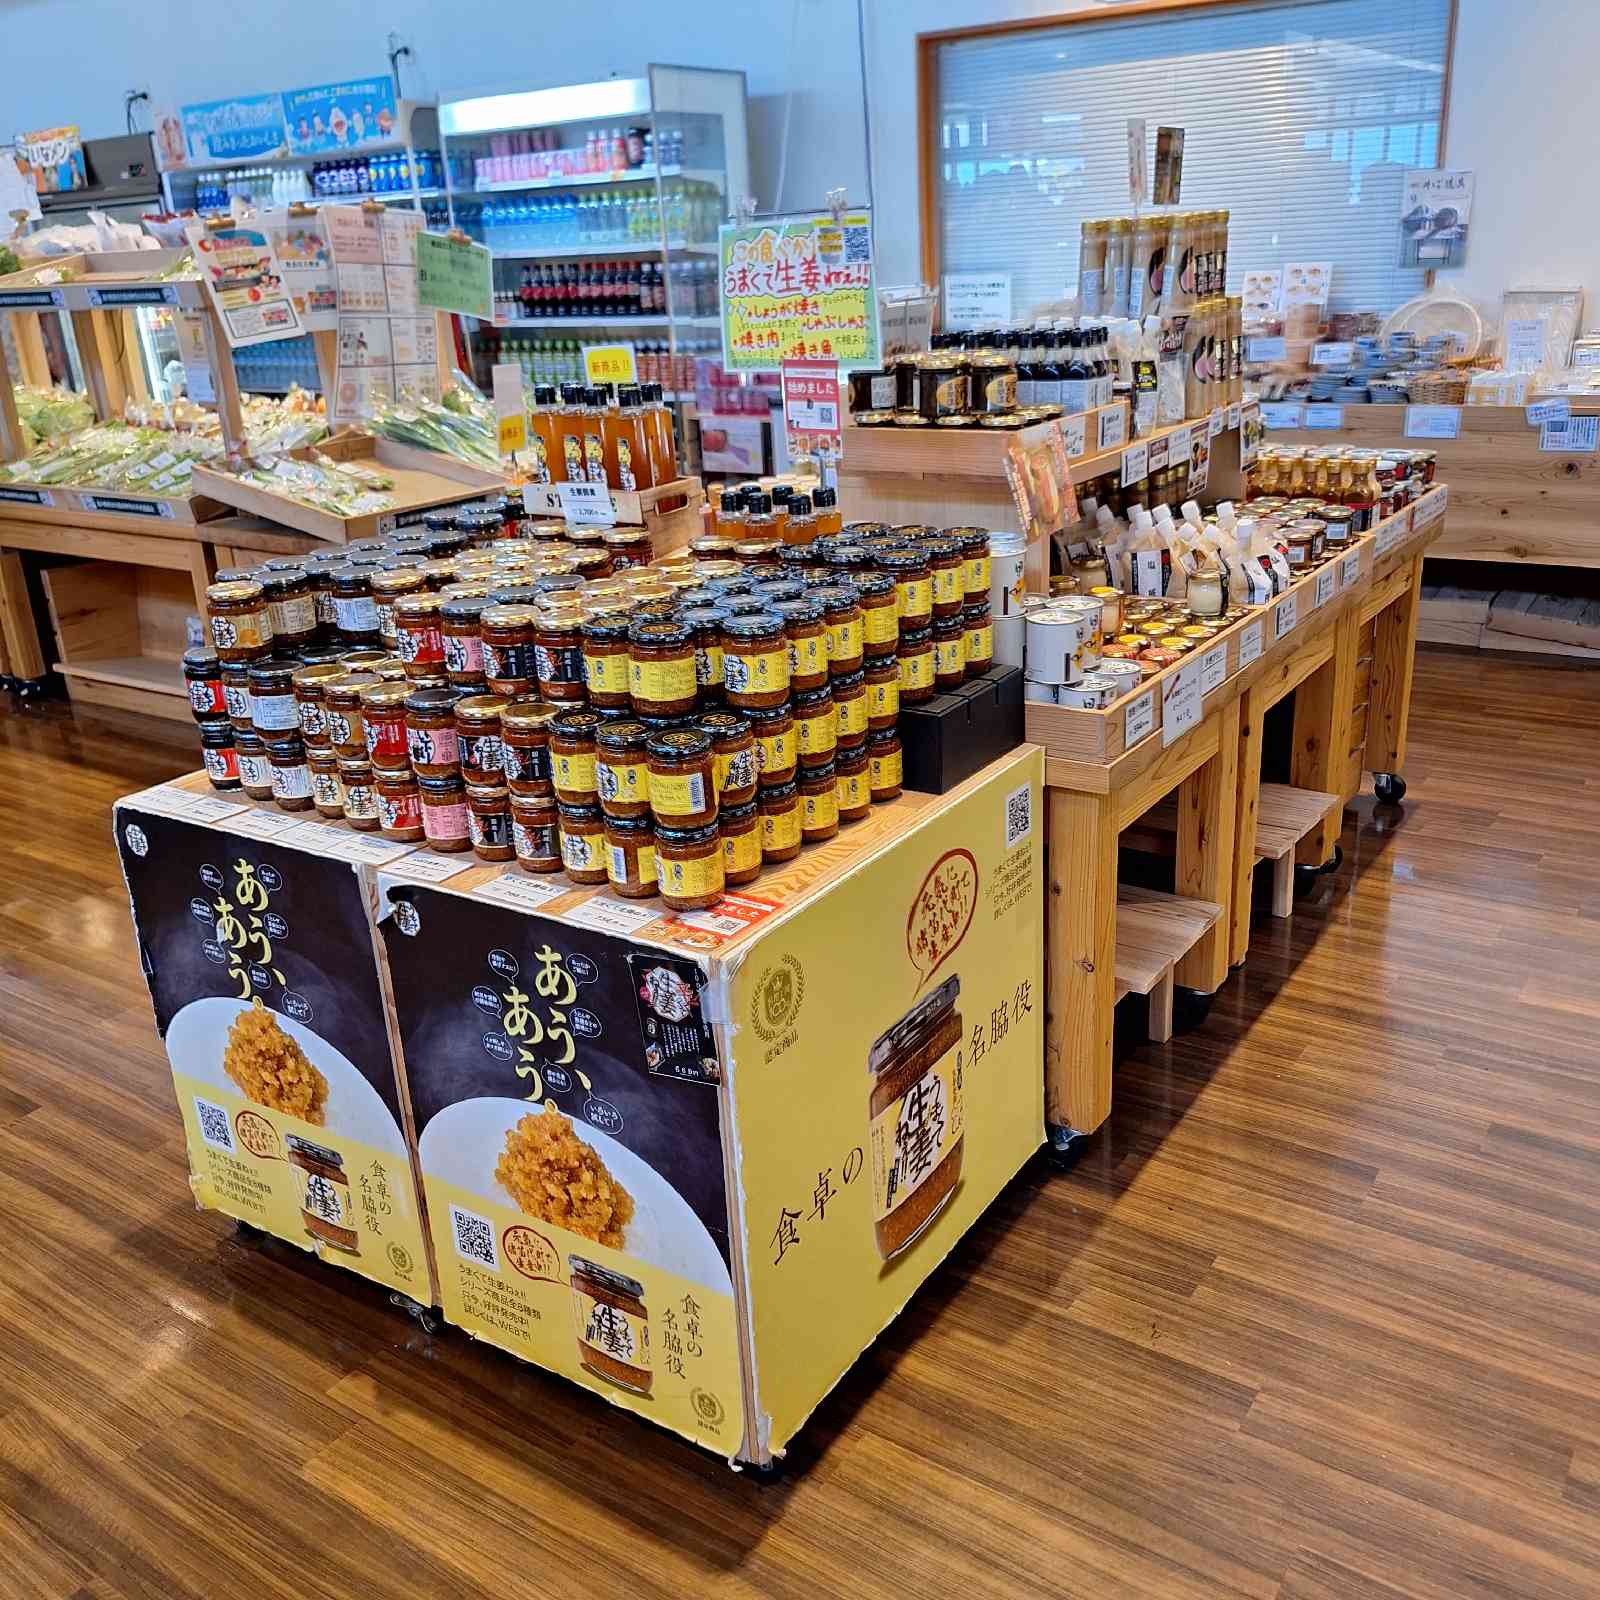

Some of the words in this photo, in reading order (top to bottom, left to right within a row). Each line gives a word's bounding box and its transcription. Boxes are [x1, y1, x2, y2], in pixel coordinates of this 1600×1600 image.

[769, 1147, 863, 1265] 食卓の
[966, 979, 1032, 1068] 名脇役
[360, 1174, 383, 1236] 名脇役
[371, 1159, 391, 1216] 食卓の
[662, 1308, 686, 1380] 名脇役
[680, 1293, 703, 1358] 食卓の
